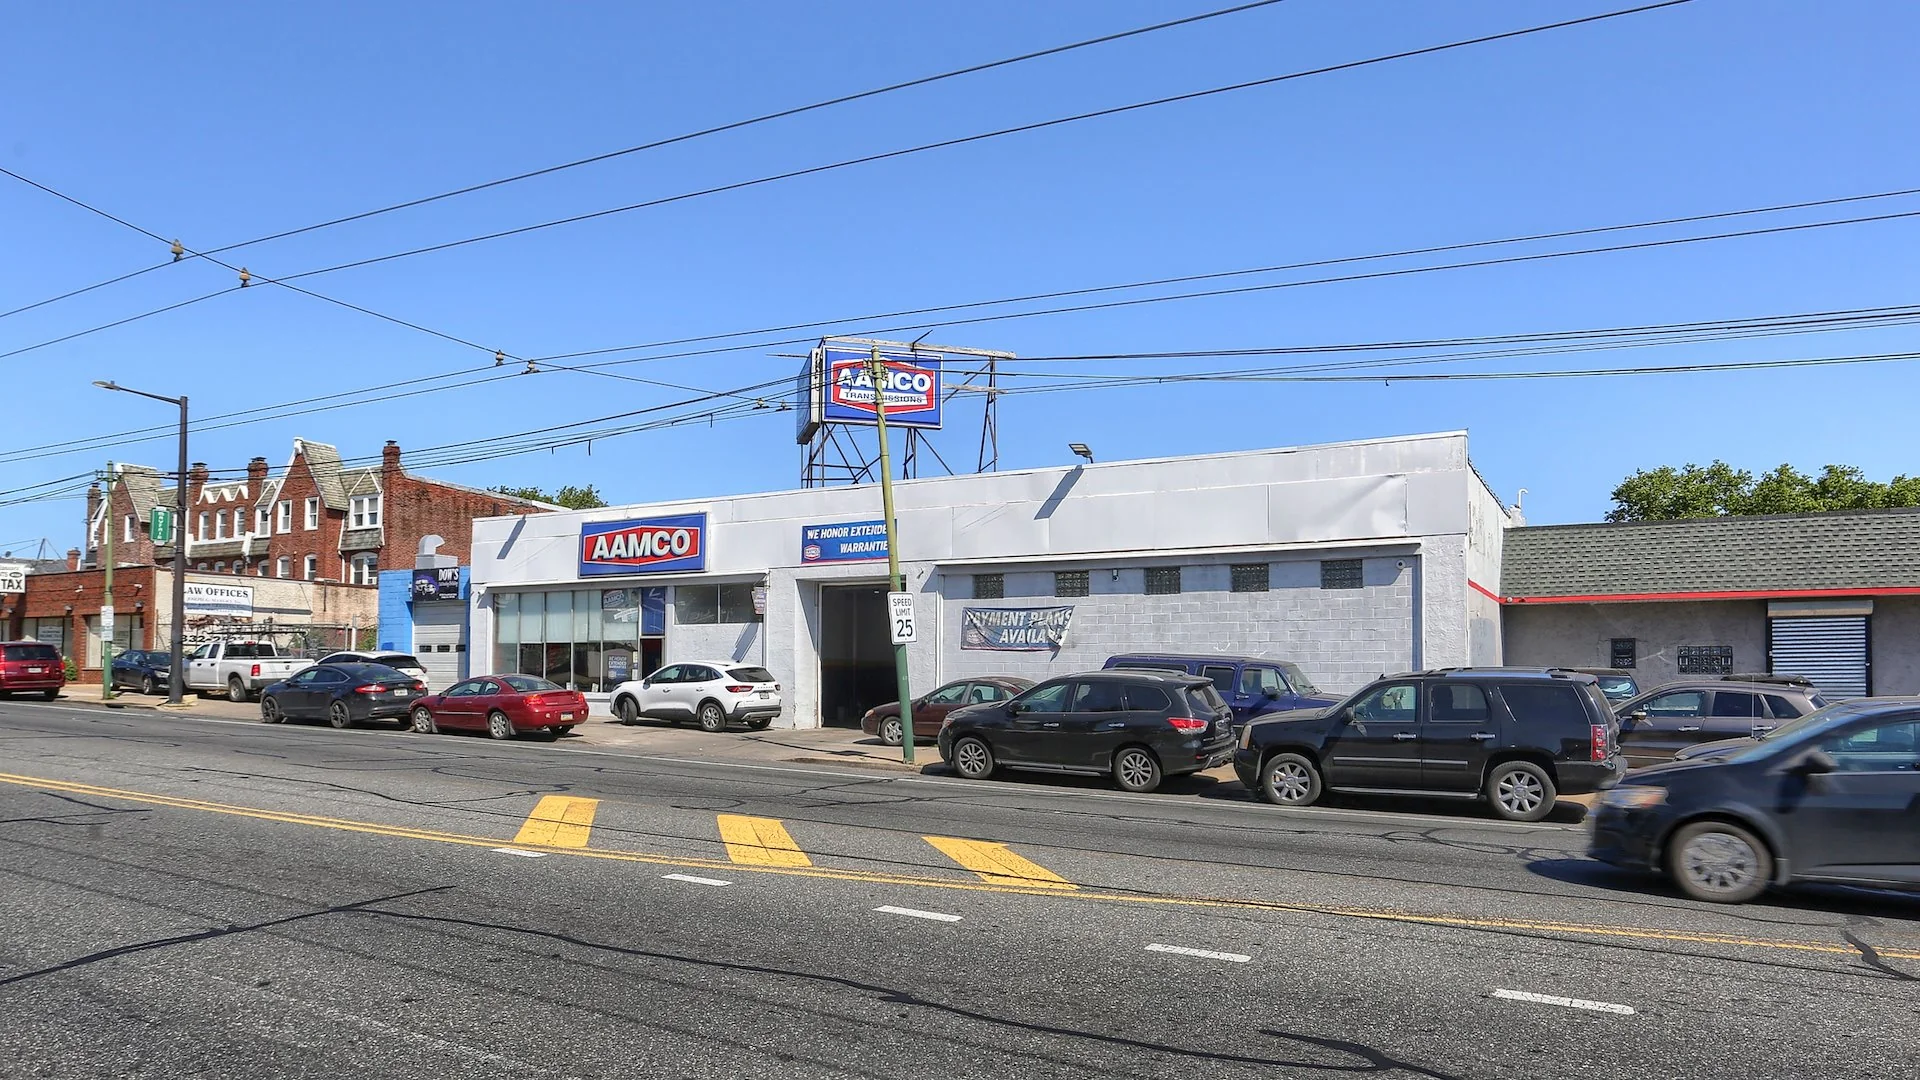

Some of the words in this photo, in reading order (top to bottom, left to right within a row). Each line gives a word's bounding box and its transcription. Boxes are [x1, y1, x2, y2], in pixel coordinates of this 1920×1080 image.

[844, 391, 923, 403] TRANSISSIONS
[807, 530, 819, 540] WE
[820, 528, 849, 539] HONOR
[850, 524, 887, 537] EXTENDE
[591, 529, 691, 560] AAMCO
[840, 541, 888, 554] WARRANTIE
[438, 568, 459, 581] DOW'S
[1, 578, 22, 590] TAX
[184, 586, 203, 595] AW
[205, 587, 249, 598] OFFICES
[892, 598, 912, 607] SPEED
[895, 608, 911, 616] LIMIT
[964, 611, 1026, 626] PAYMENT
[896, 619, 913, 637] 25
